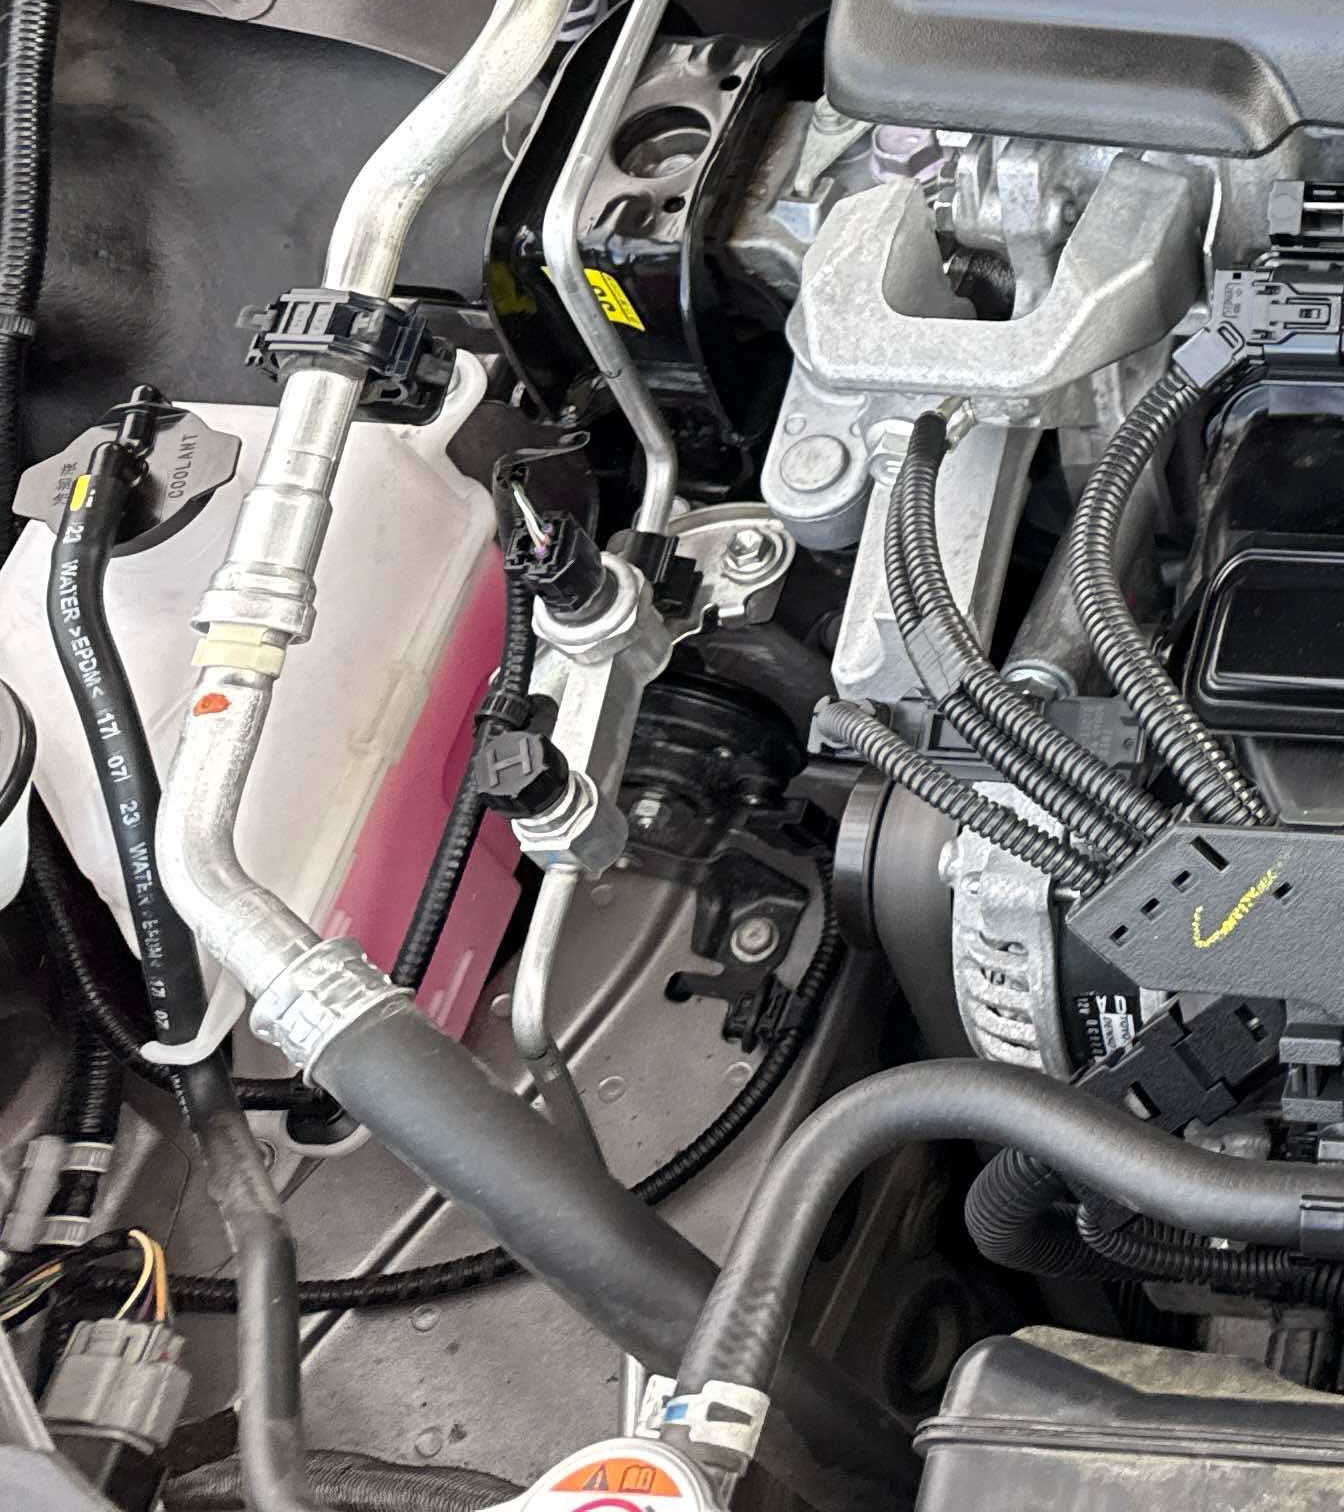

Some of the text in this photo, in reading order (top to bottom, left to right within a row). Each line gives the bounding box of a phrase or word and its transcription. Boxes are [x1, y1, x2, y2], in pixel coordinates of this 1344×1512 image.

[168, 433, 199, 499] COOLANT
[59, 559, 81, 623] WATER
[69, 625, 105, 699] >EPDM<
